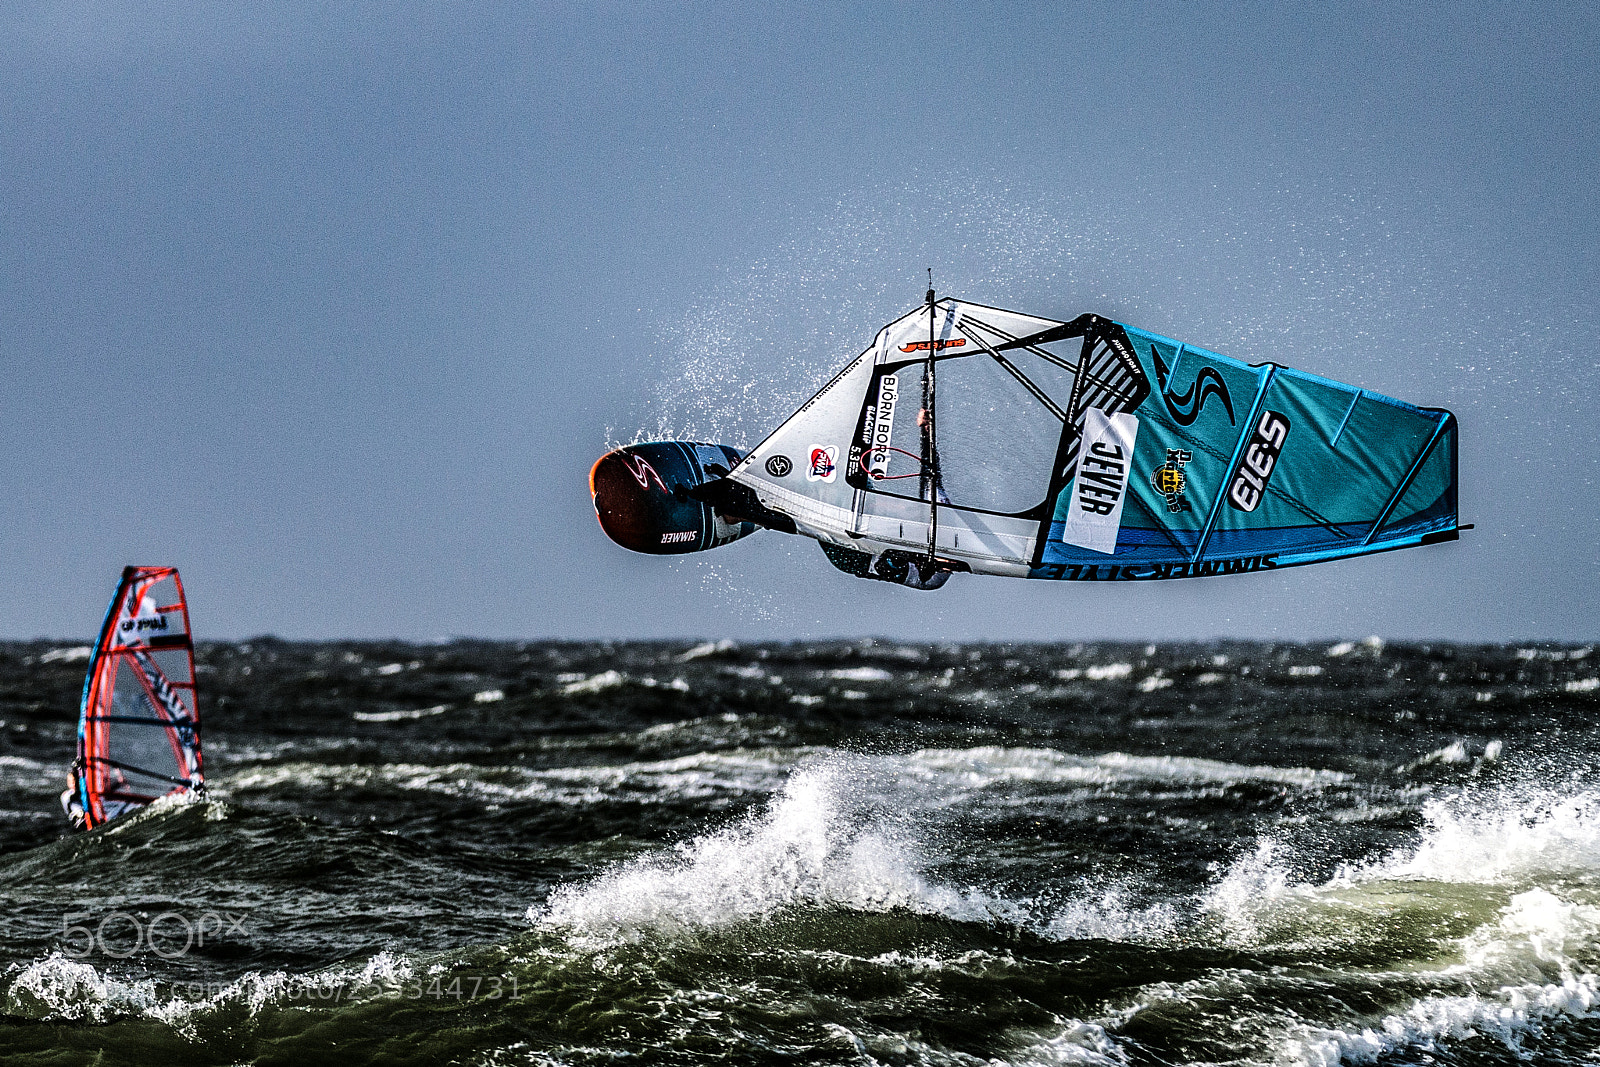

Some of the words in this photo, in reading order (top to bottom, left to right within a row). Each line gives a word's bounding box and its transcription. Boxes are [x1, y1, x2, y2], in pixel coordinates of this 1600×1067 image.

[879, 377, 898, 421] BJÖRN
[862, 405, 876, 444] BLACKTIP
[873, 423, 890, 463] BORG
[1078, 442, 1125, 516] JEVER
[660, 531, 697, 544] SIMMER
[1150, 552, 1280, 580] SIMMER
